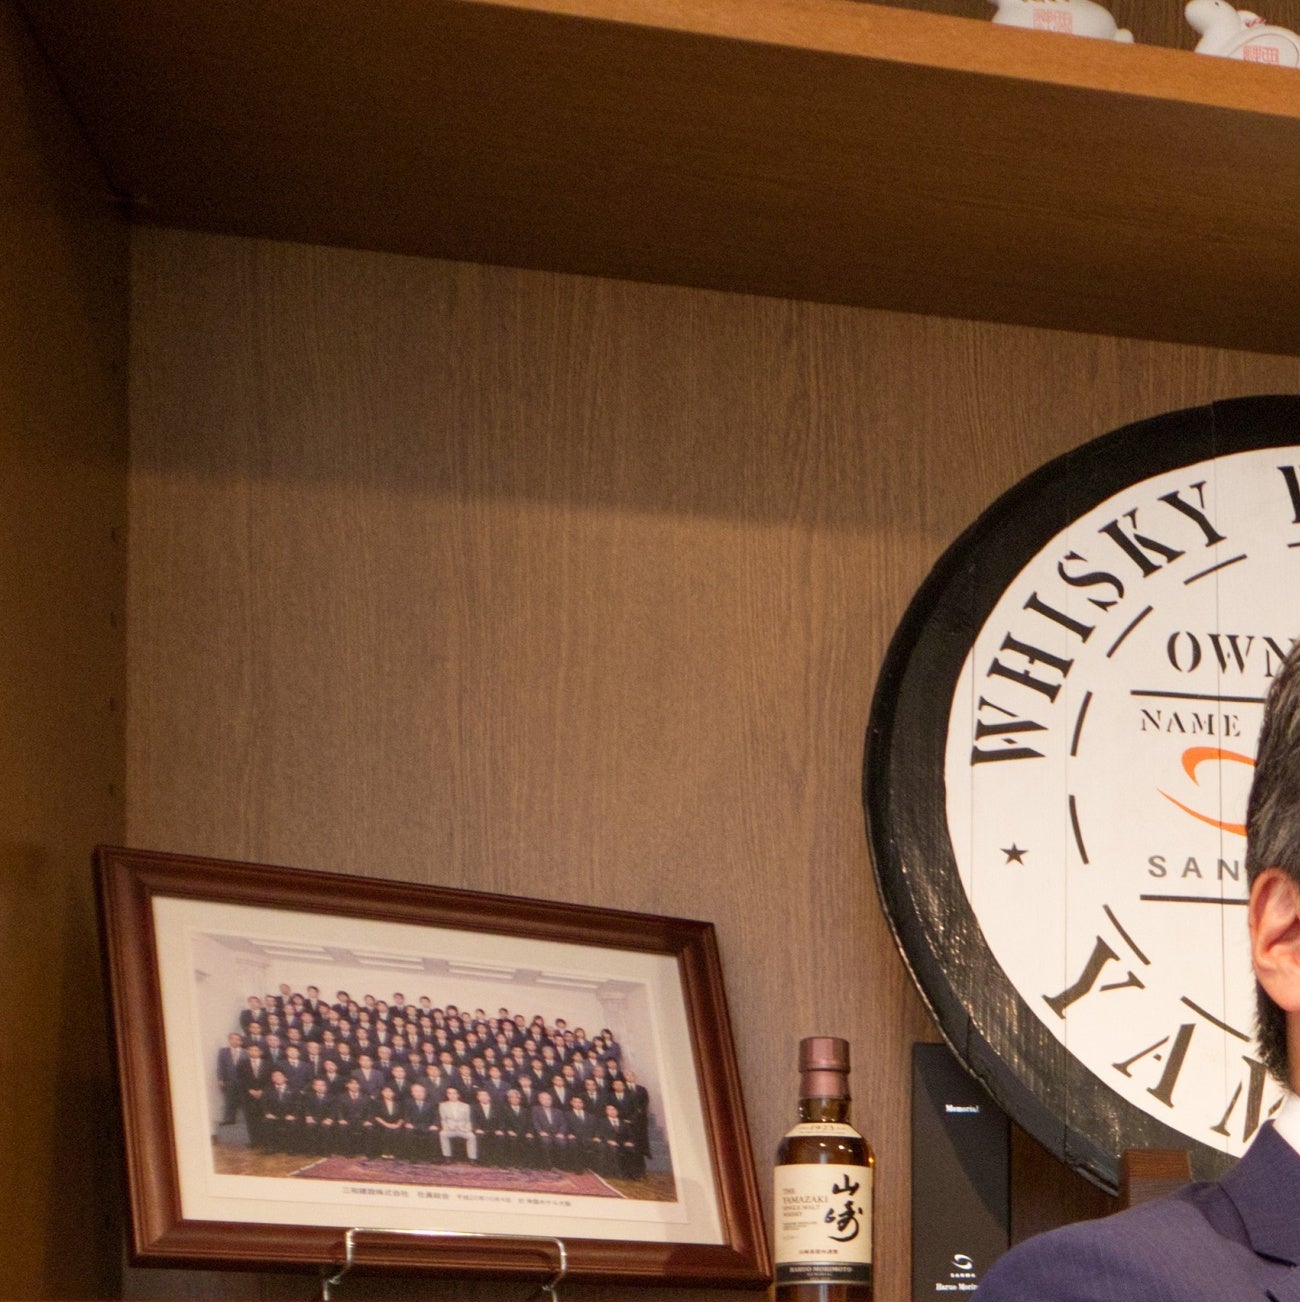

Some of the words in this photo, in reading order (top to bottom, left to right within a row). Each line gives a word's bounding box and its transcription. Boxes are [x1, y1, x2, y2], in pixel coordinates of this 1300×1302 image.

[970, 480, 1228, 768] WHISKY
[1166, 631, 1295, 678] OWN
[1140, 709, 1241, 737] NAME
[1148, 855, 1240, 881] SAN
